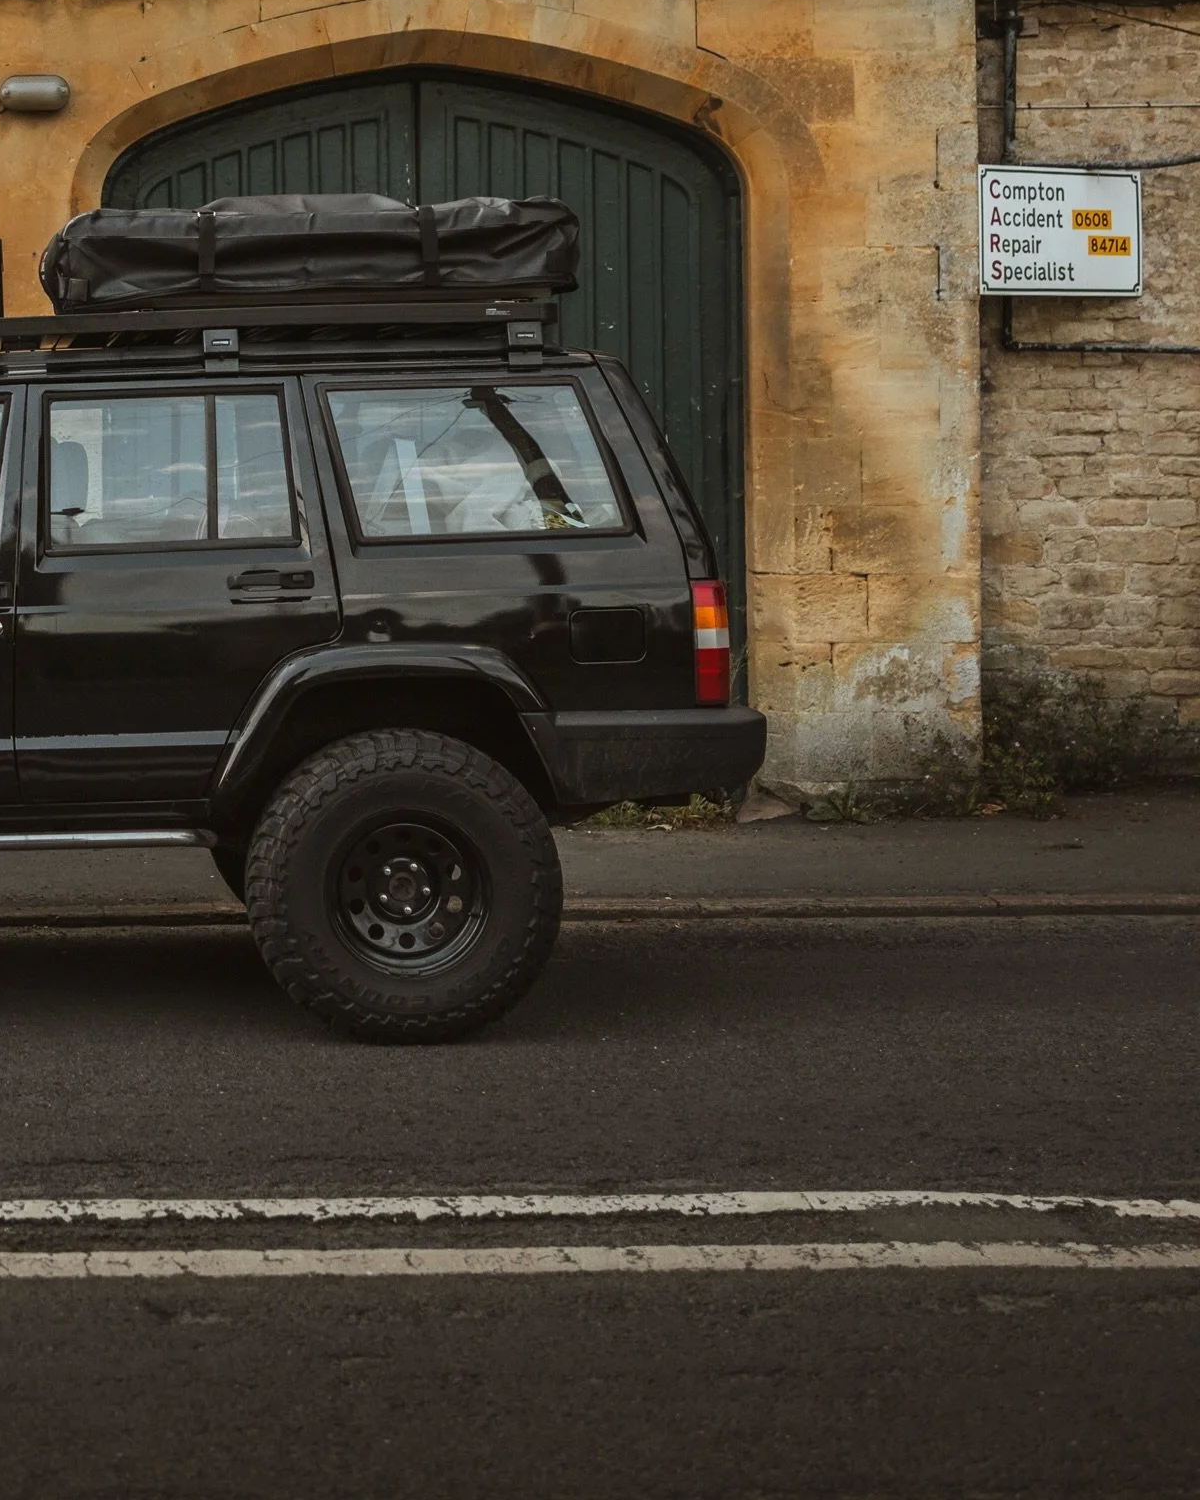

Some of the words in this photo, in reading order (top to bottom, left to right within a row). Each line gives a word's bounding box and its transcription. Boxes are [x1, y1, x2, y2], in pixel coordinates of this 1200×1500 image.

[989, 179, 1065, 204] Compton
[990, 206, 1064, 228] Accident
[1075, 212, 1109, 227] 0608
[990, 233, 1042, 257] Repair
[1091, 238, 1128, 253] 84714
[991, 260, 1075, 284] Specialist
